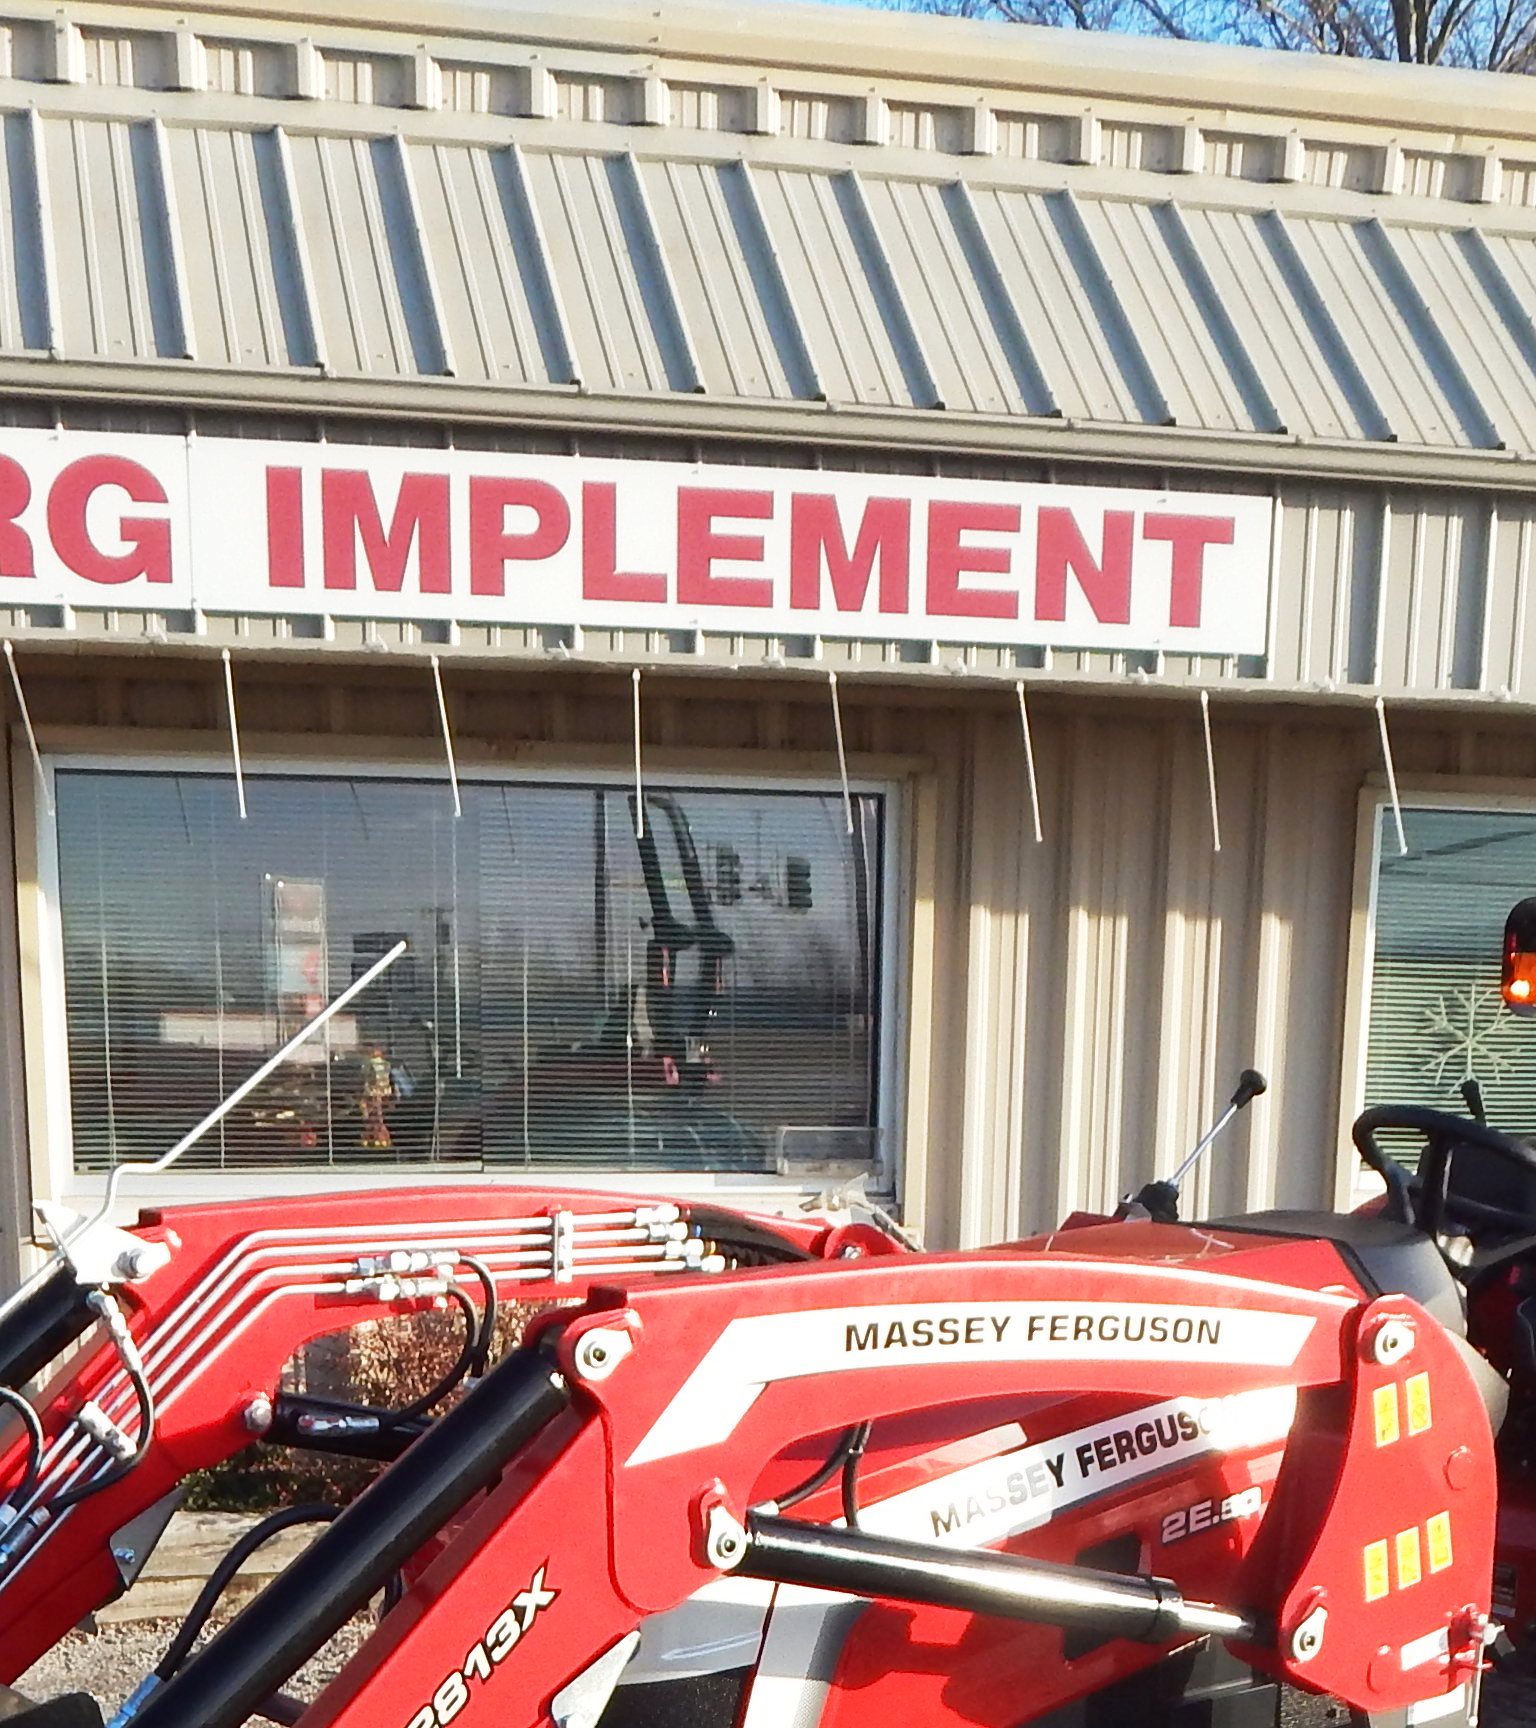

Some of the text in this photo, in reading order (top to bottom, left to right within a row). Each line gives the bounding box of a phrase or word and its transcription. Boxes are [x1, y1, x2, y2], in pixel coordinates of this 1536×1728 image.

[266, 466, 1232, 627] IMPLEMENT
[844, 1314, 1222, 1352] MASSEY FERGUSON
[929, 1452, 1065, 1538] MASSEY
